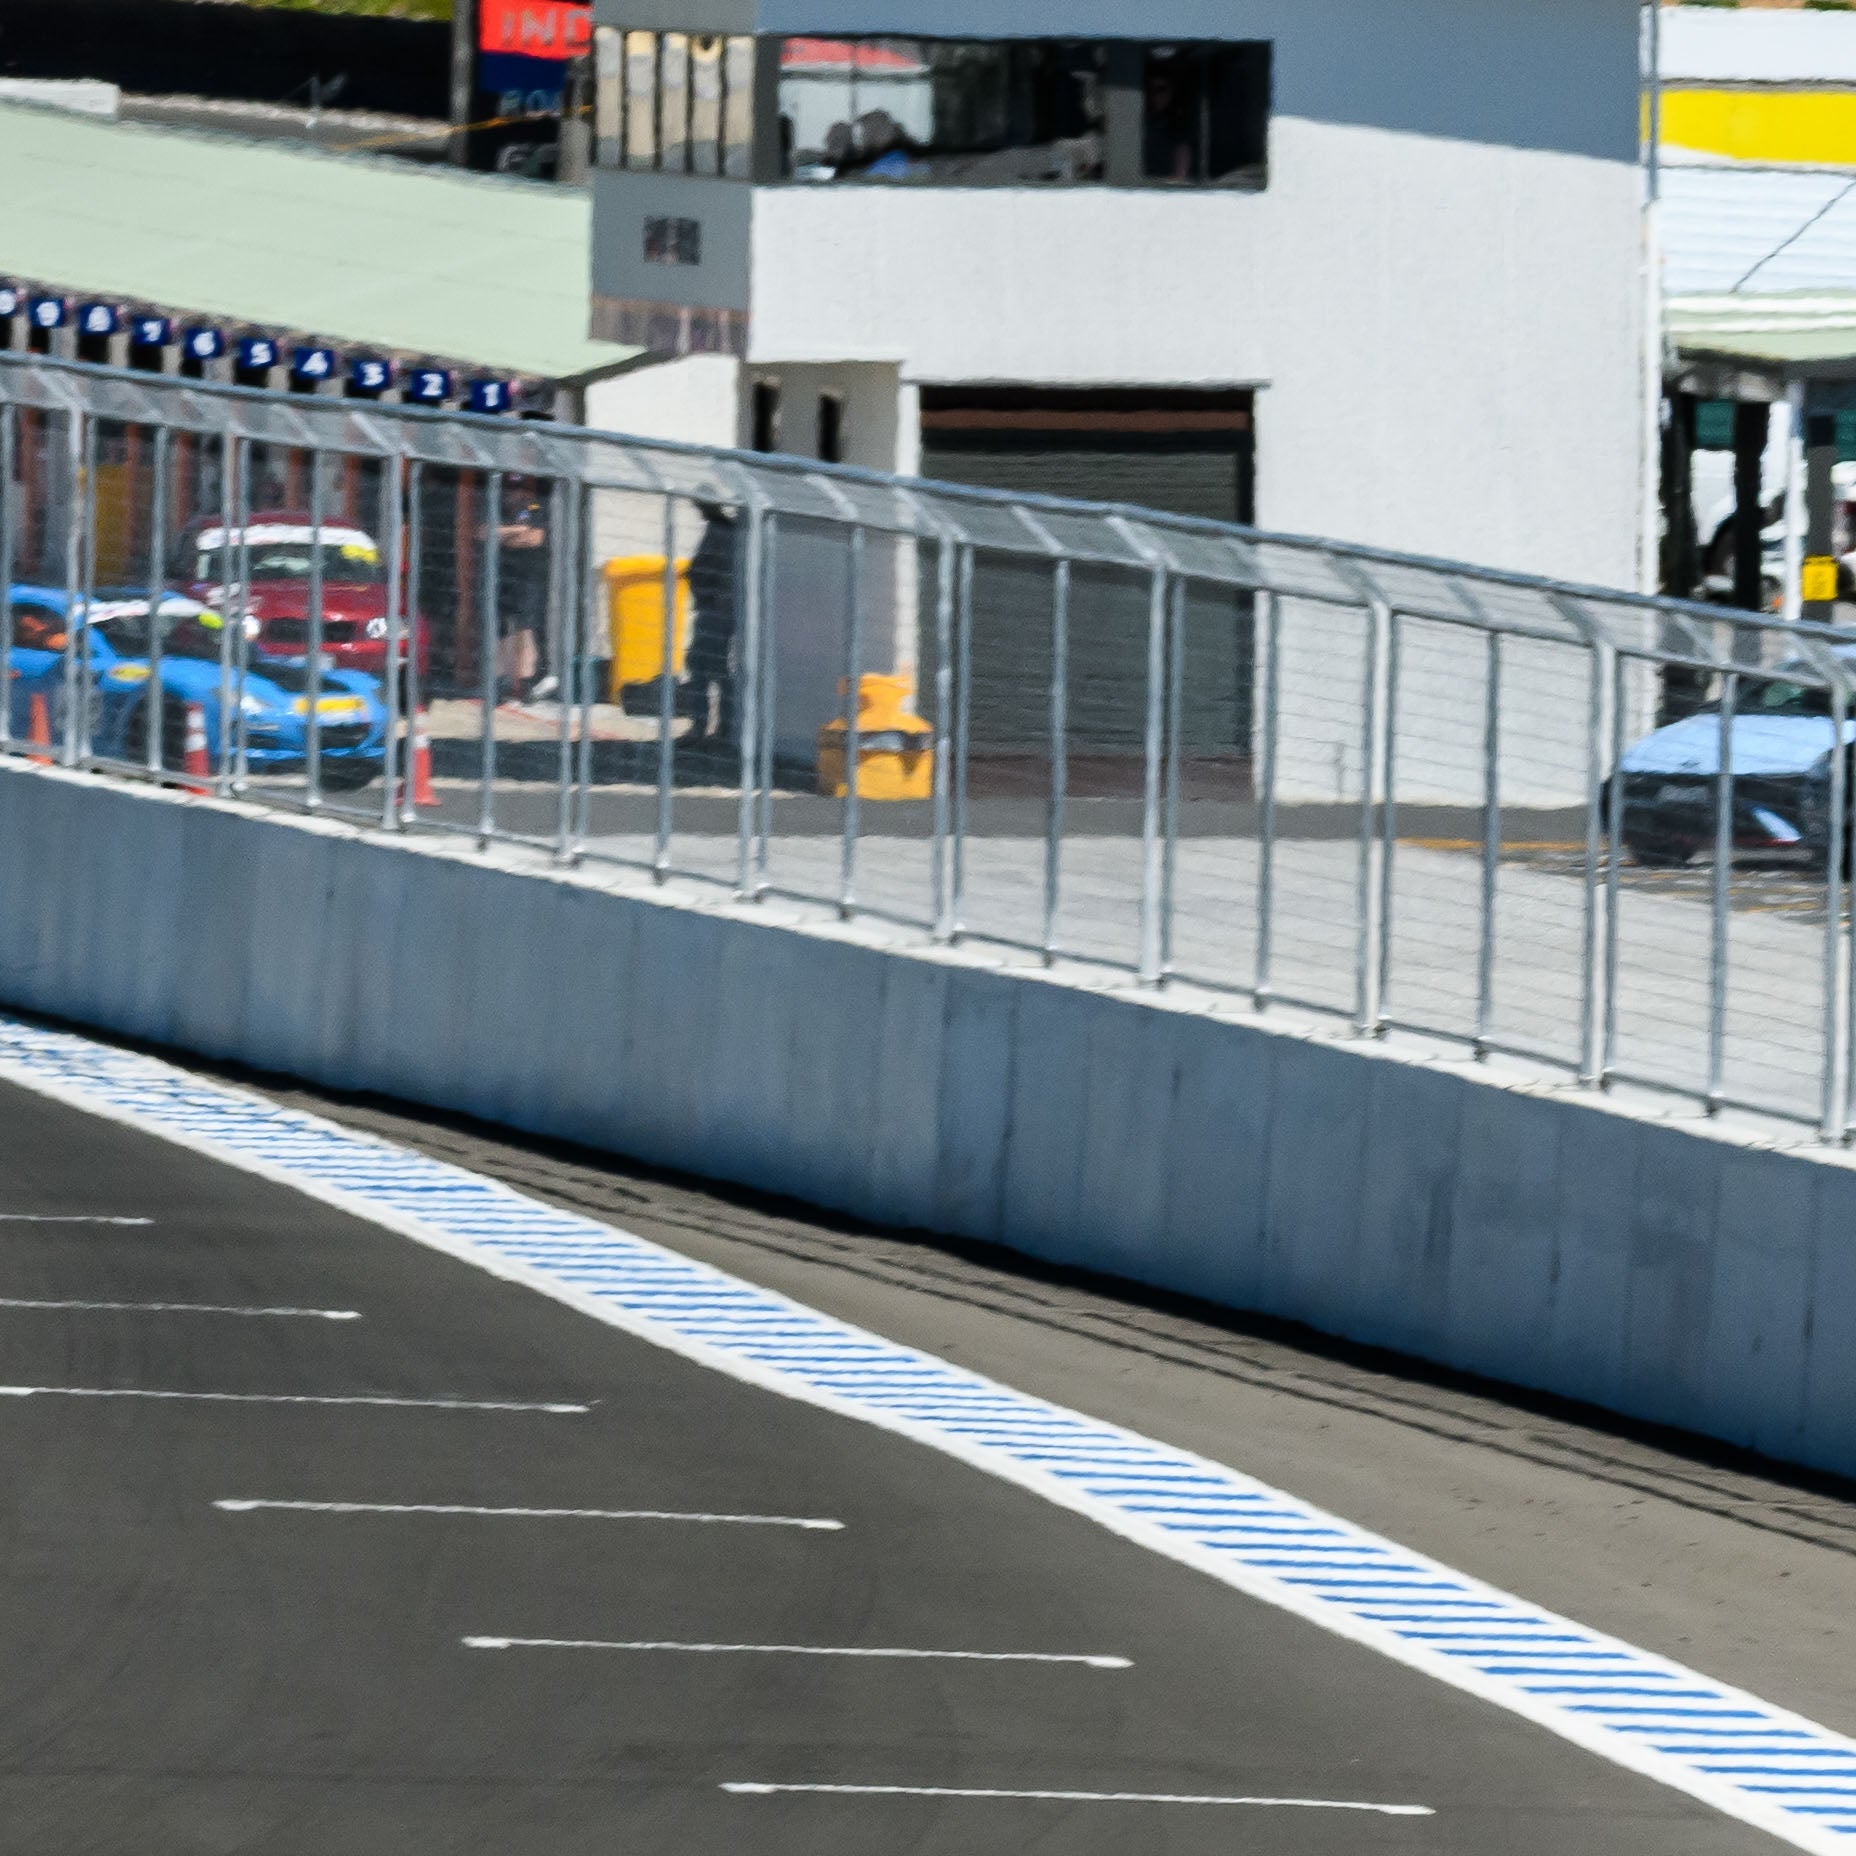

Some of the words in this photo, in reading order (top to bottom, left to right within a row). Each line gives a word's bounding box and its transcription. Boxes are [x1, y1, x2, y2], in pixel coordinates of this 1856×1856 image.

[142, 321, 162, 341] 7
[194, 331, 215, 356] 6
[251, 343, 271, 366] 5
[301, 352, 328, 374] 4
[361, 363, 384, 385] 3
[422, 374, 443, 396] 2
[483, 384, 499, 407] 1
